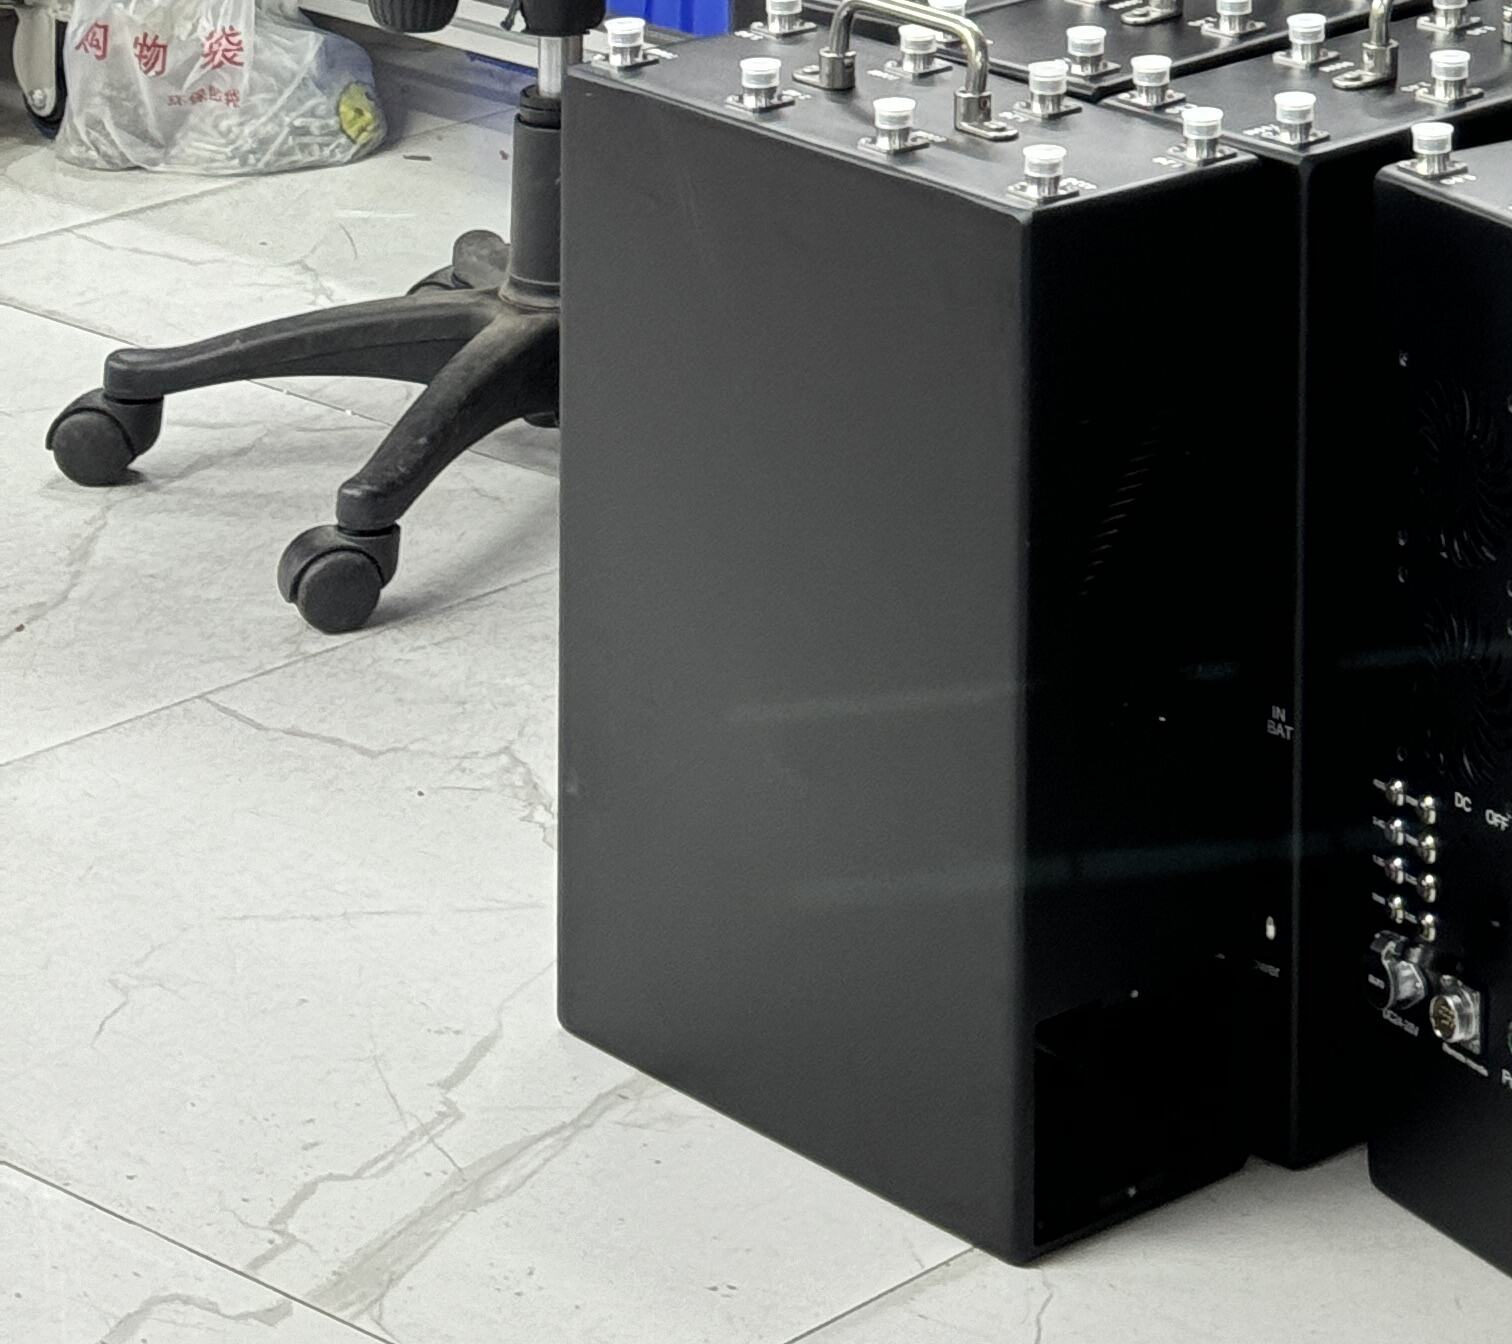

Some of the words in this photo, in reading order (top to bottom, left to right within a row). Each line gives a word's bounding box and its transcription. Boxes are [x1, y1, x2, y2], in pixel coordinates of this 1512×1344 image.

[1267, 719, 1294, 741] BAT
[1454, 791, 1472, 812] DC
[1485, 808, 1512, 831] OFF
